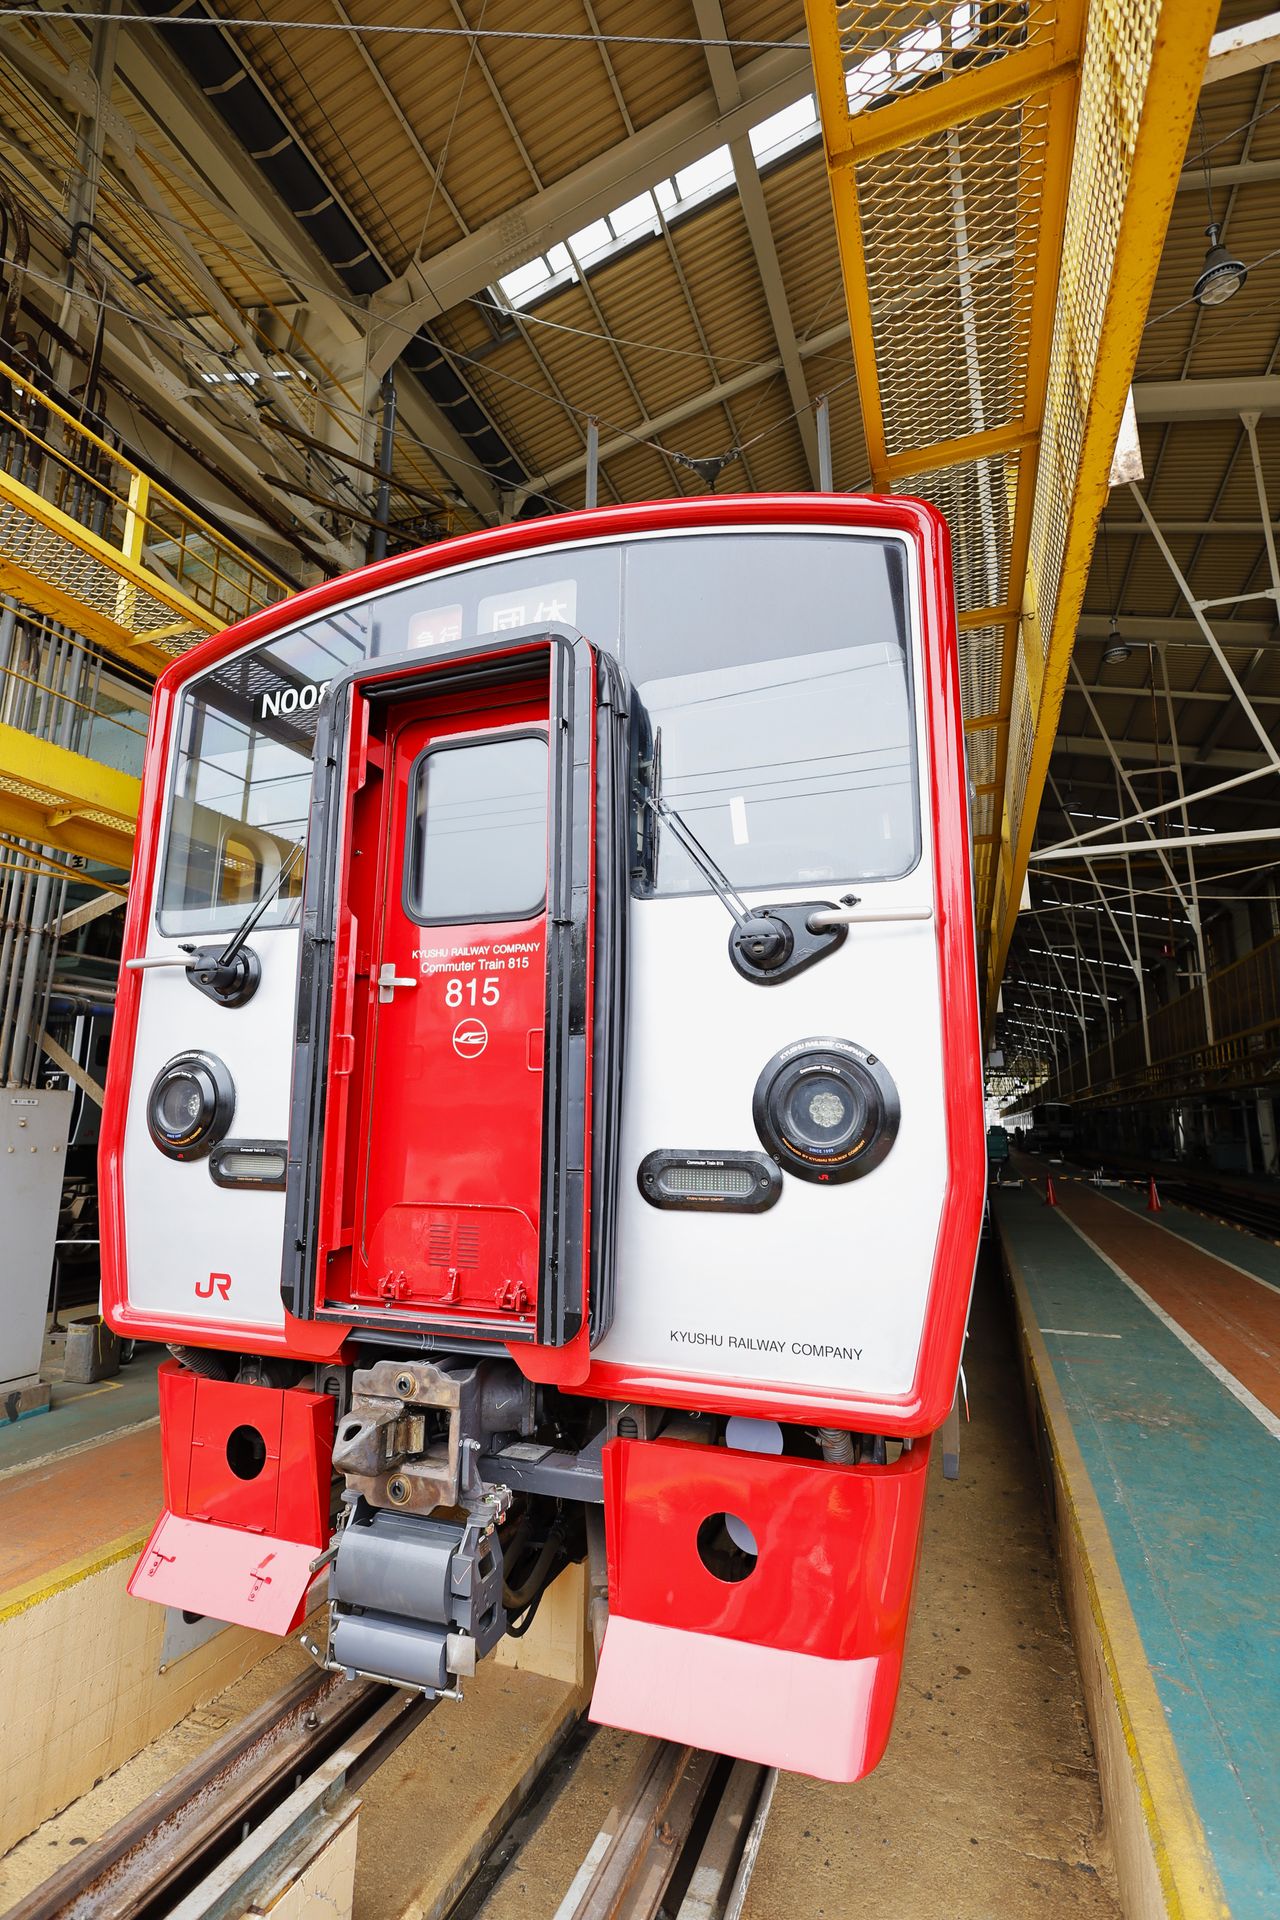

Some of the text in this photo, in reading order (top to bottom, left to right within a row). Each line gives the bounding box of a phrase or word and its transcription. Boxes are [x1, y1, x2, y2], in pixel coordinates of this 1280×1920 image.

[412, 942, 541, 959] KYUSHU RAILWAY COMPANY
[421, 957, 530, 974] Commuter Train 815
[445, 977, 500, 1008] 815
[835, 1042, 868, 1060] COMPANY
[195, 1272, 232, 1301] JR
[670, 1330, 863, 1361] KYUSHU RAILWAY COMPANY
